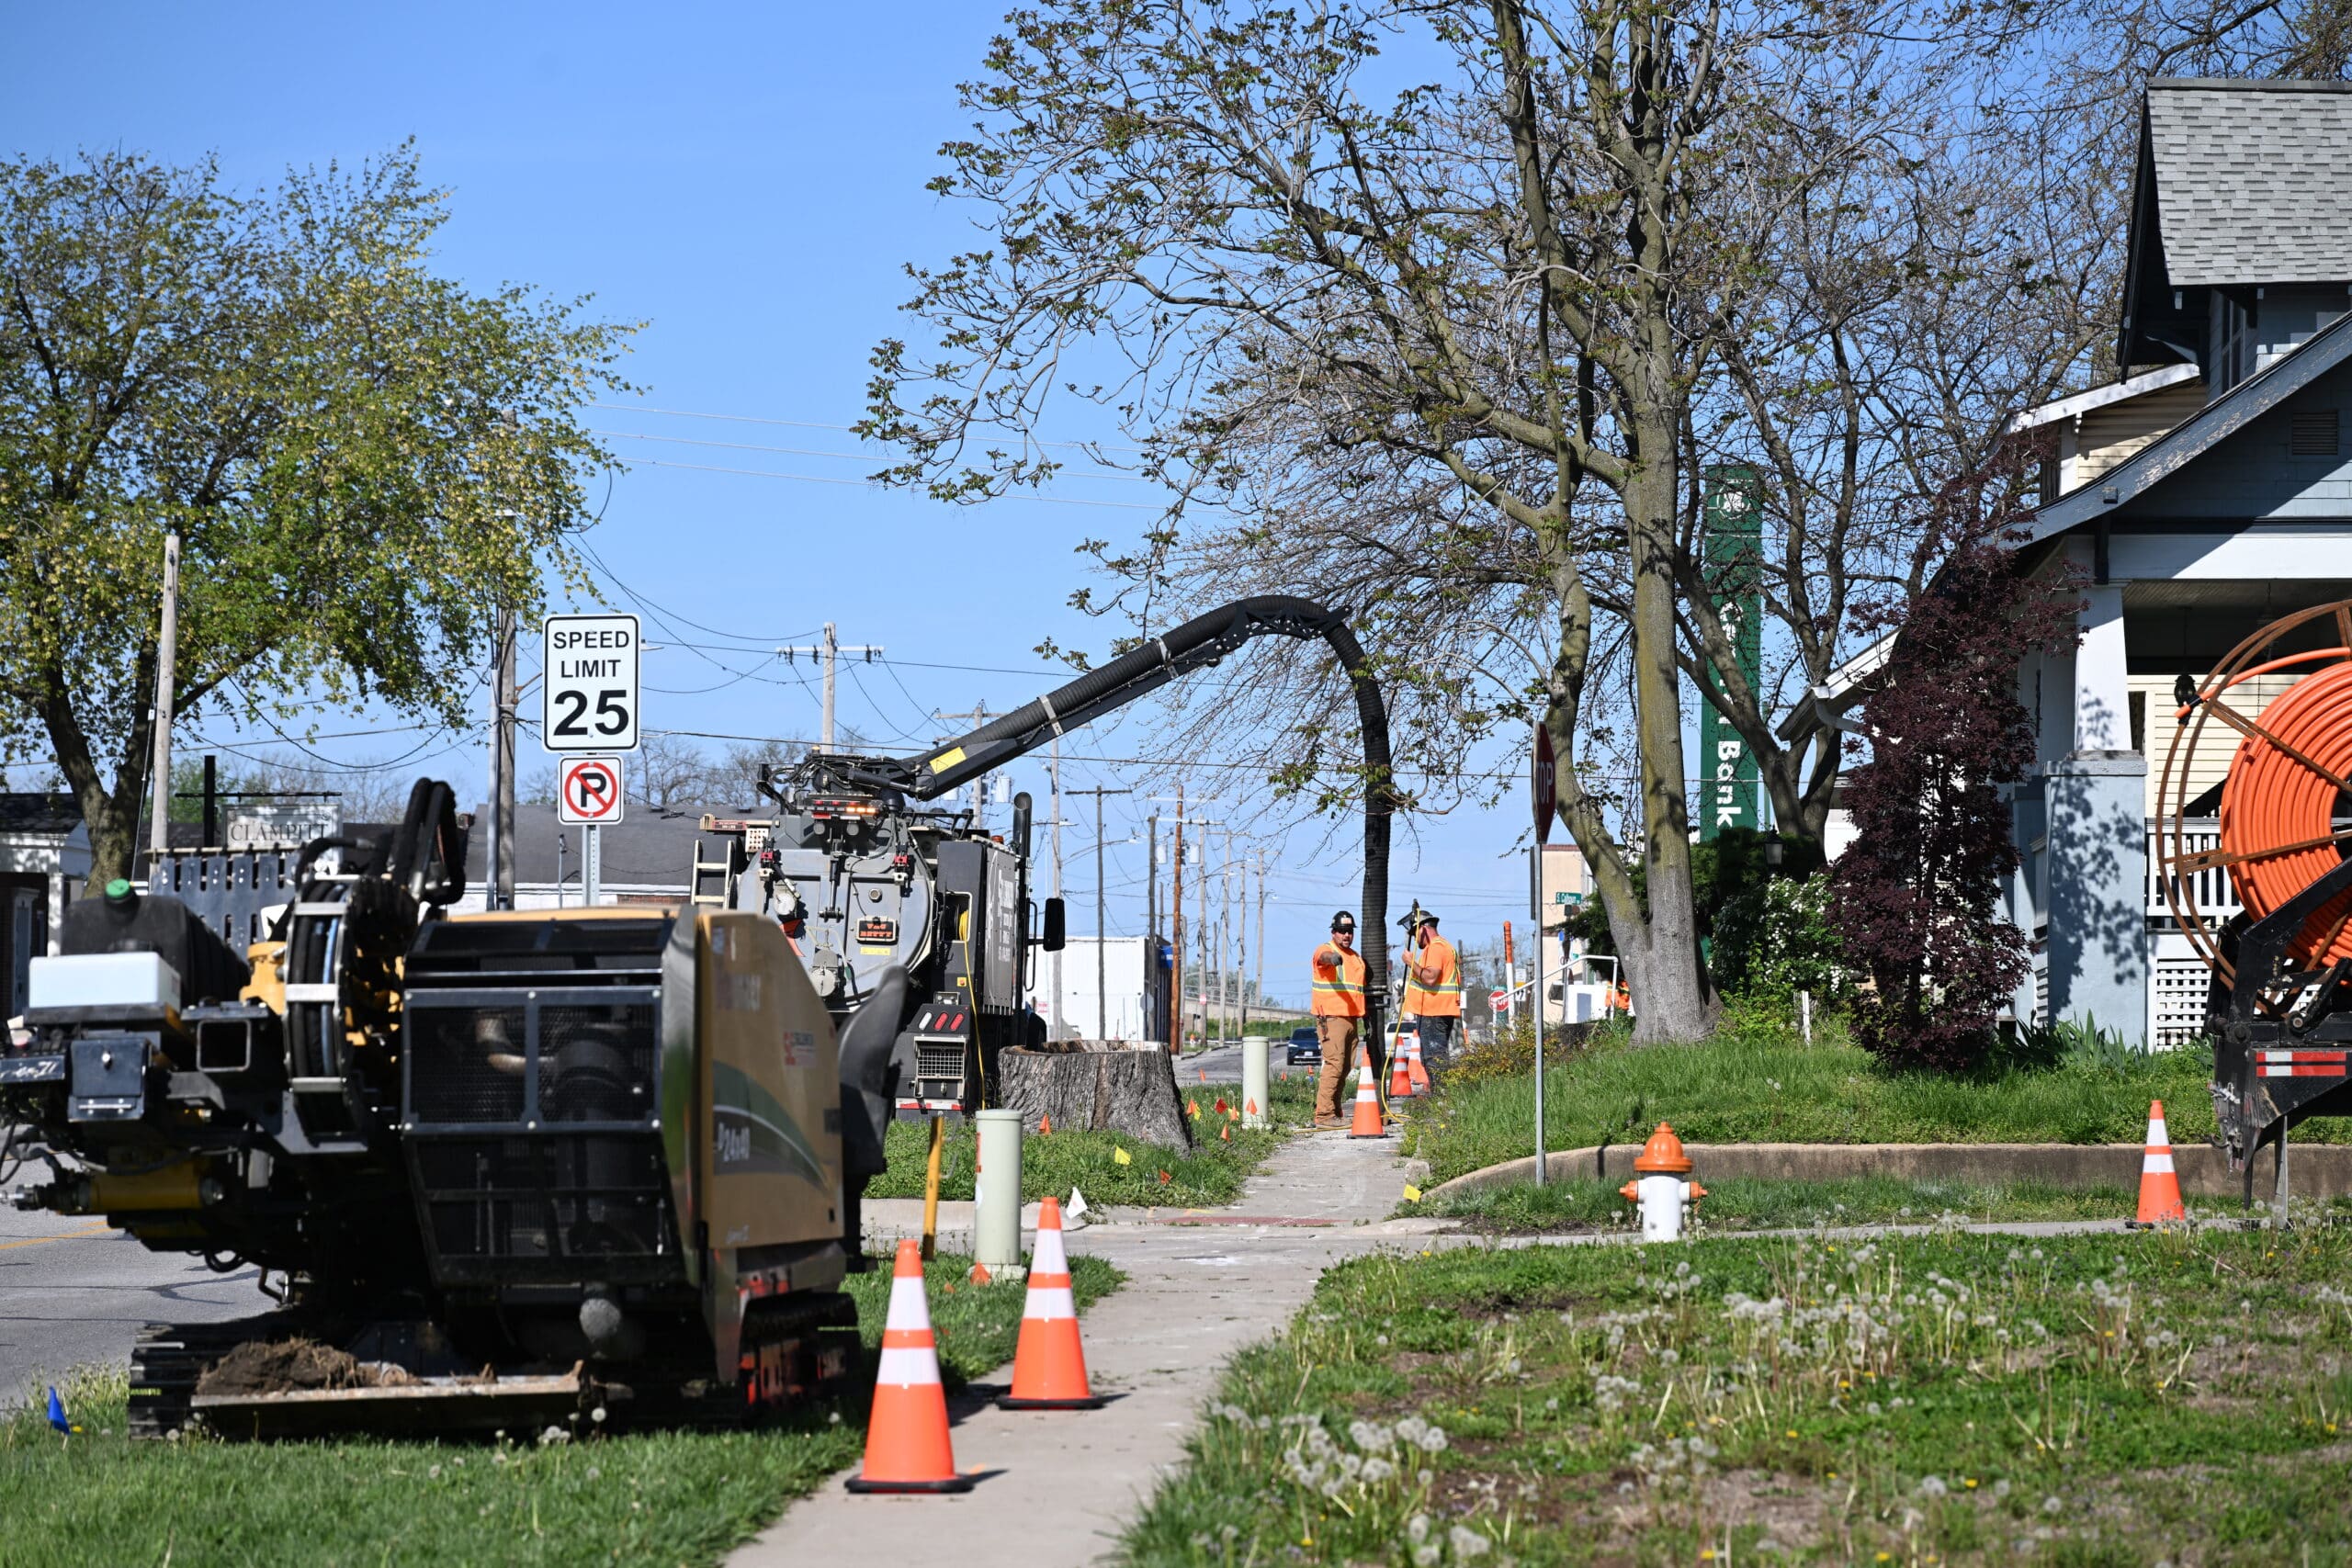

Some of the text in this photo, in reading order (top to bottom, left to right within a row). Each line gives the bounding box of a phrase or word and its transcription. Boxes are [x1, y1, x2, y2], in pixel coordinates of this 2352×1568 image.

[553, 630, 629, 649] SPEED
[560, 659, 621, 678] LIMIT
[553, 689, 629, 736] 25
[580, 772, 607, 808] P
[1716, 740, 1742, 829] Bank
[231, 823, 329, 841] CLAMPITT
